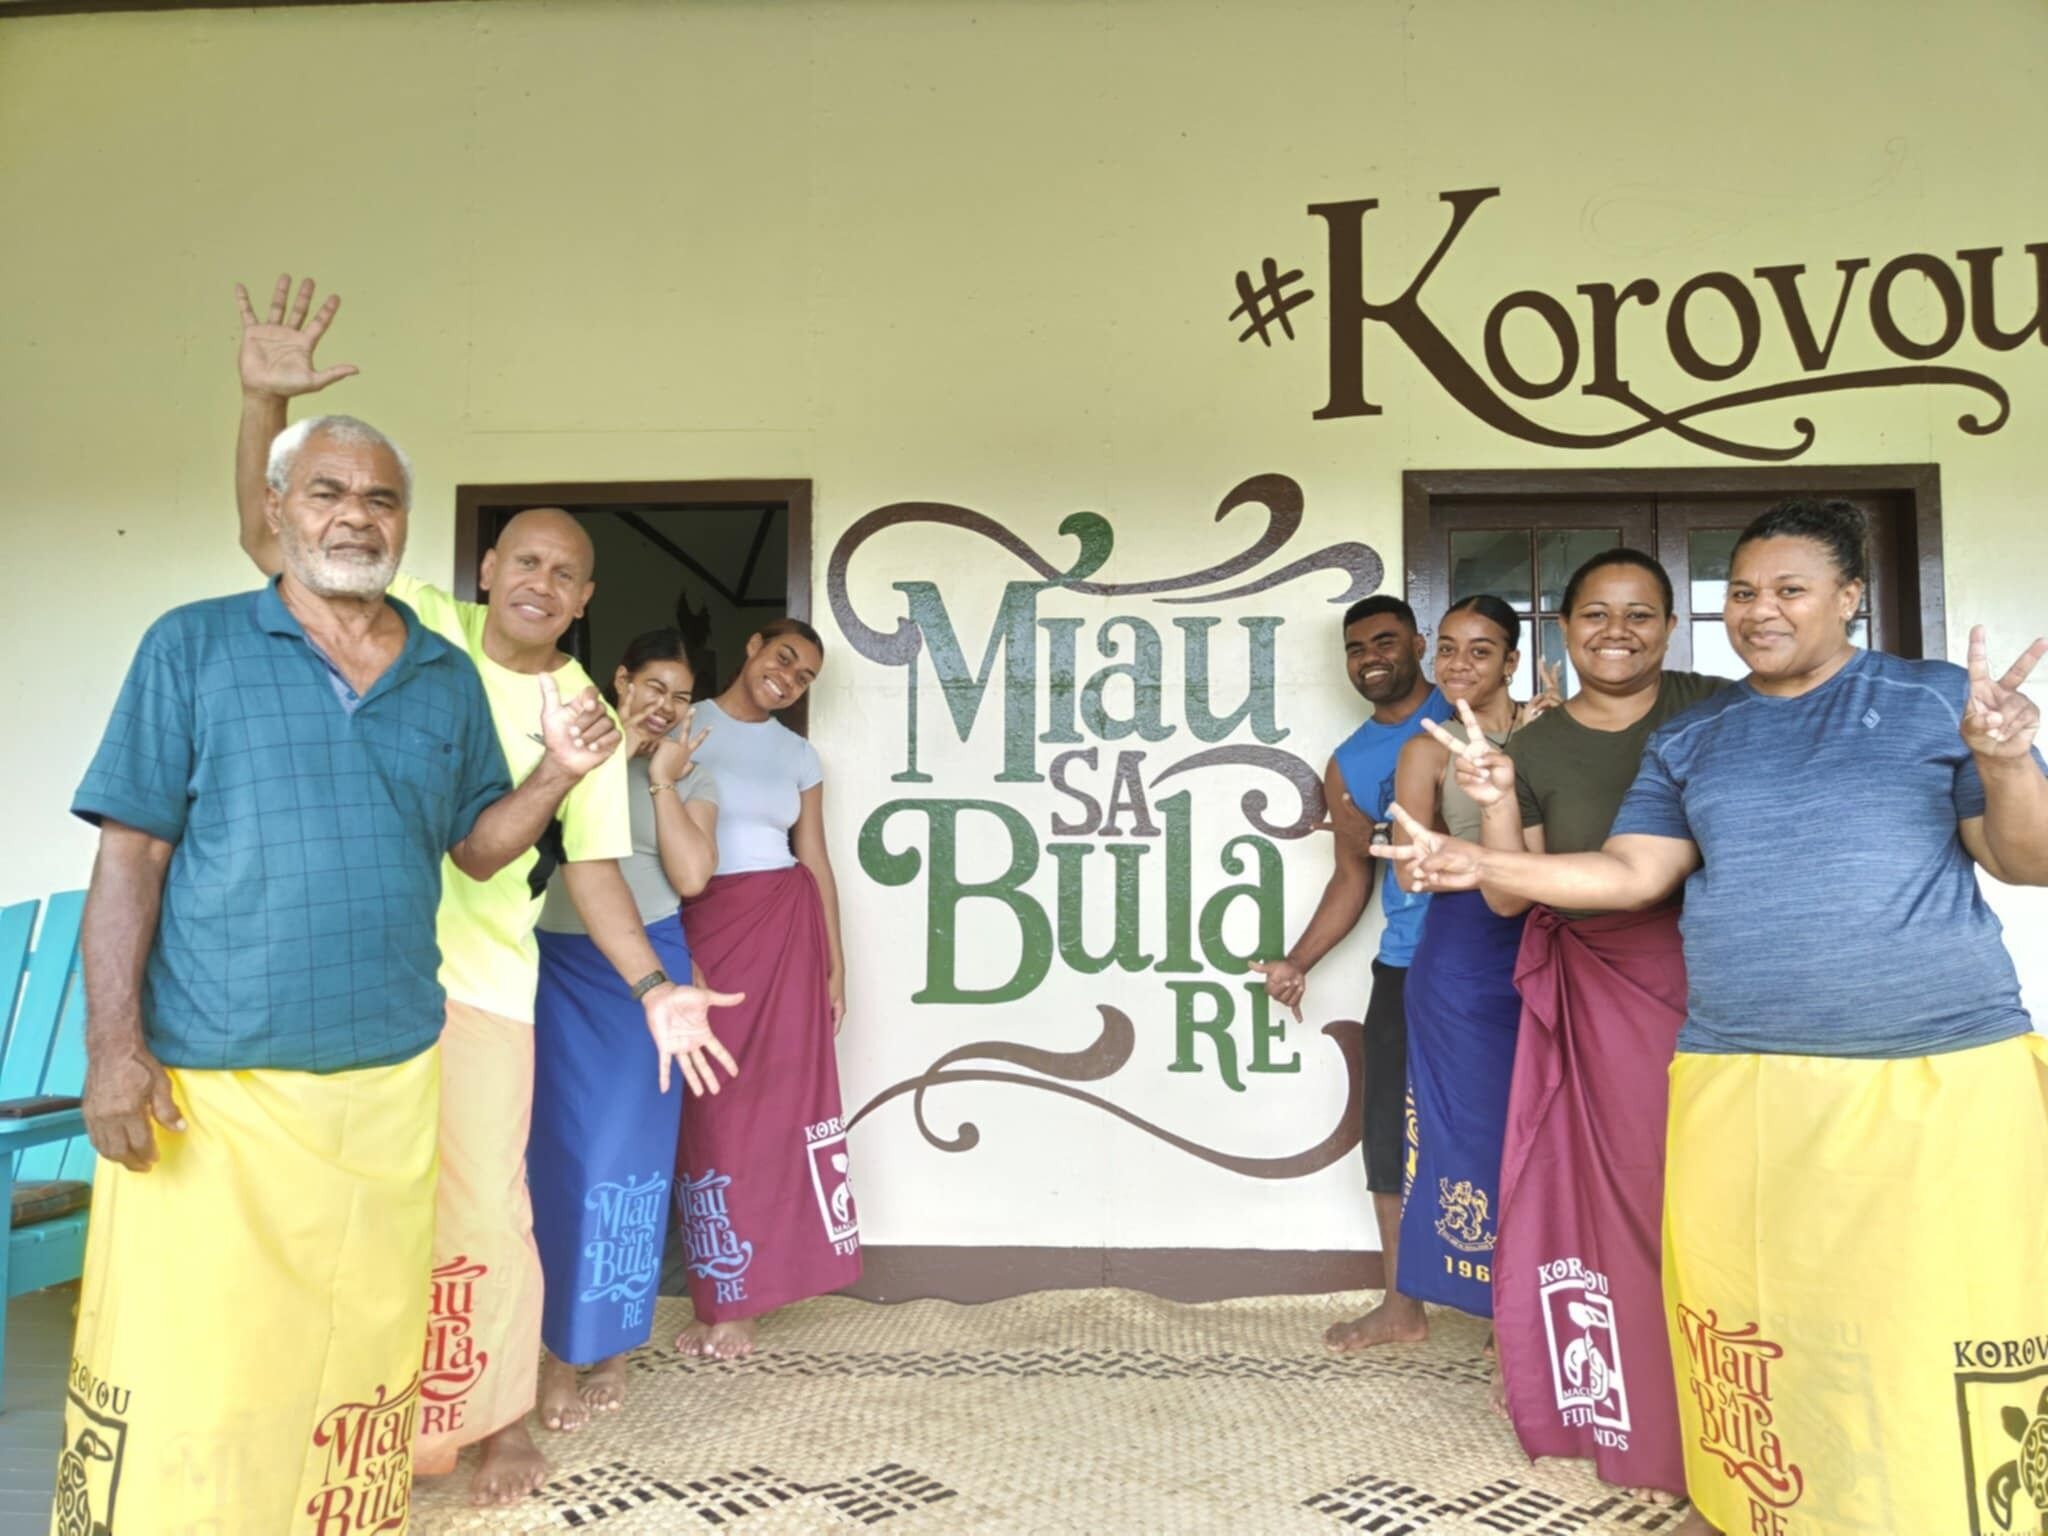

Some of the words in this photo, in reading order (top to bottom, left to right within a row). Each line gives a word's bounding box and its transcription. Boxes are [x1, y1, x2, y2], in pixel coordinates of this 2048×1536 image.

[1048, 746, 1161, 838] SA
[858, 789, 1287, 1004] Bula
[1164, 979, 1301, 1092] RE
[716, 1279, 748, 1303] RE
[1537, 1257, 1608, 1295] KOROU
[622, 1299, 645, 1329] RE
[1717, 1382, 1740, 1412] SA
[422, 1401, 467, 1434] RE
[1690, 1377, 1787, 1474] Bula
[363, 1461, 388, 1487] SA
